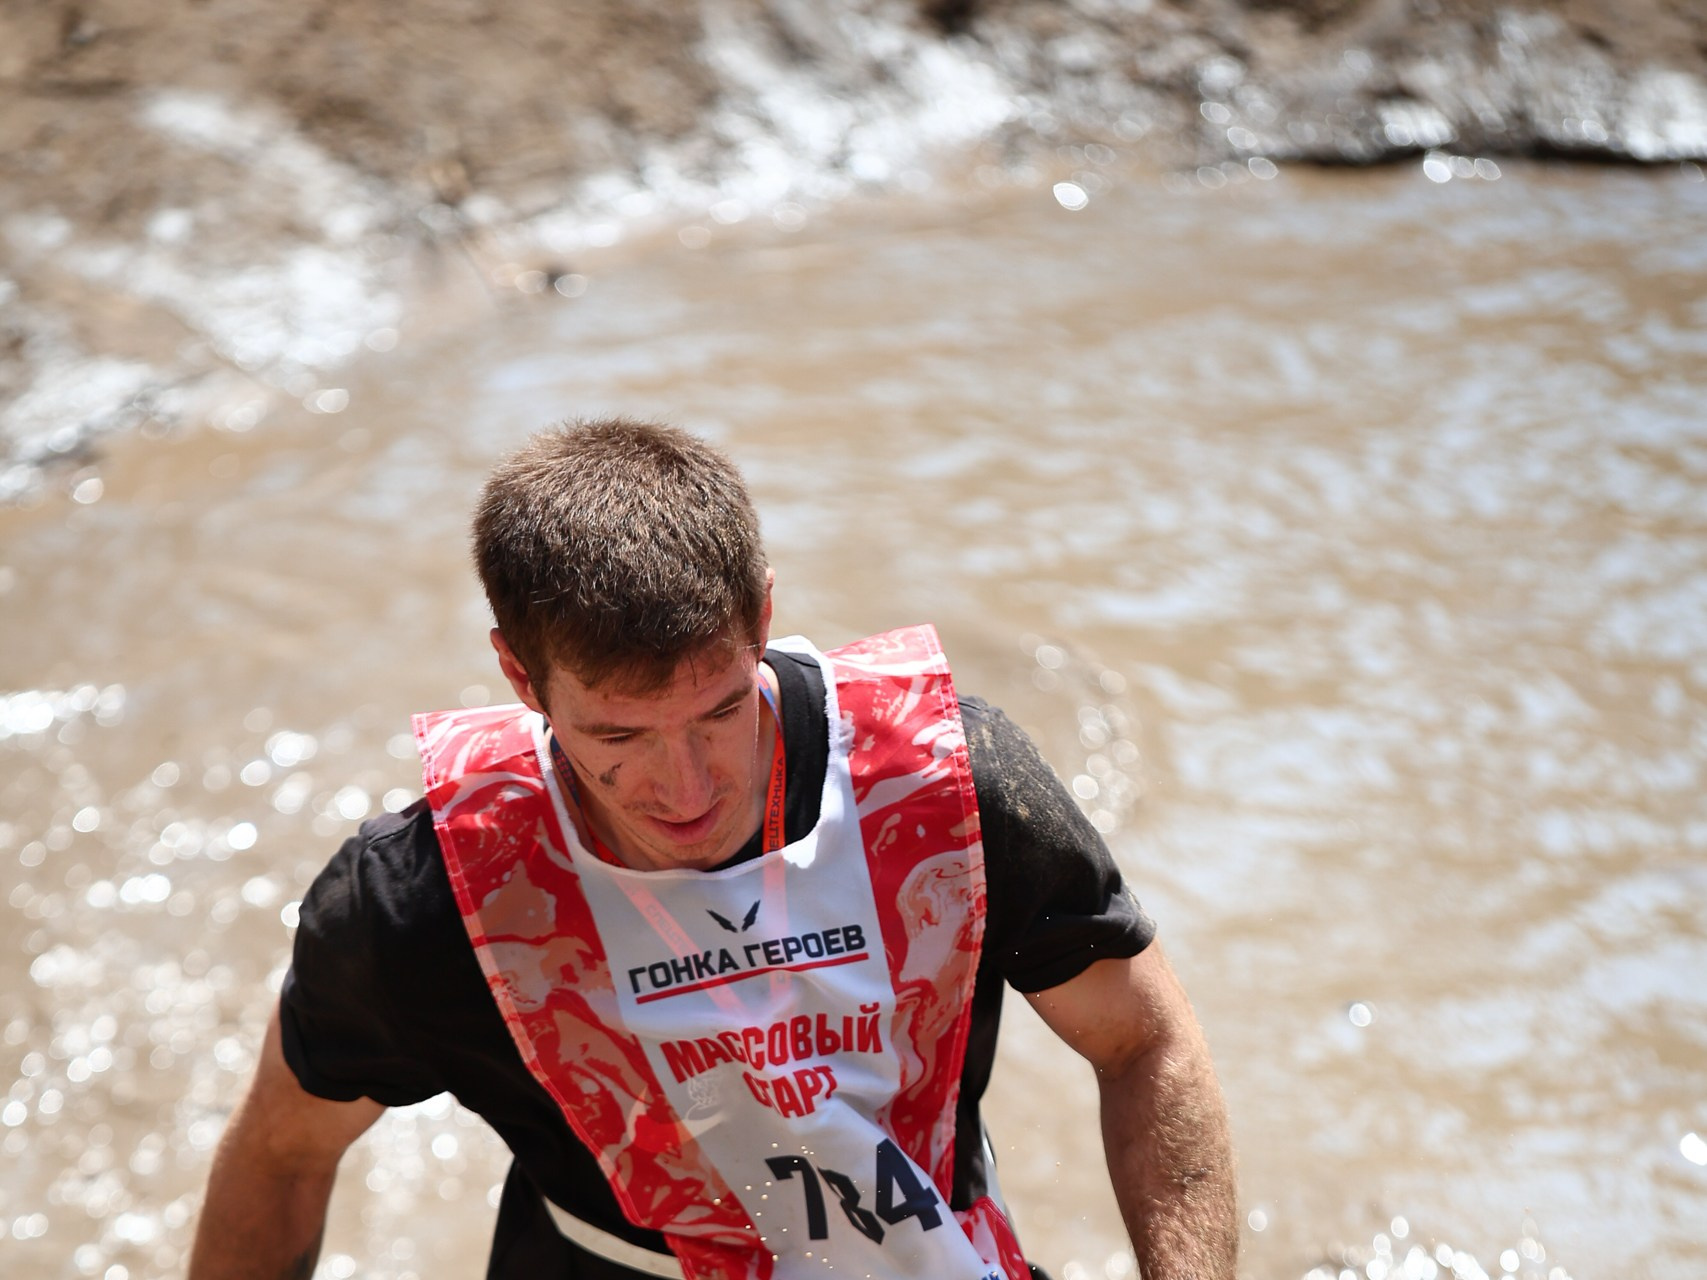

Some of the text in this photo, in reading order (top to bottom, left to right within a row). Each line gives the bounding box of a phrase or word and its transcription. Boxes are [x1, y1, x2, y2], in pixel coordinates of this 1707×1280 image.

[628, 924, 866, 994] ГОНКА ГЕРОЕВ
[660, 1002, 883, 1084] МАССОВЫЙ
